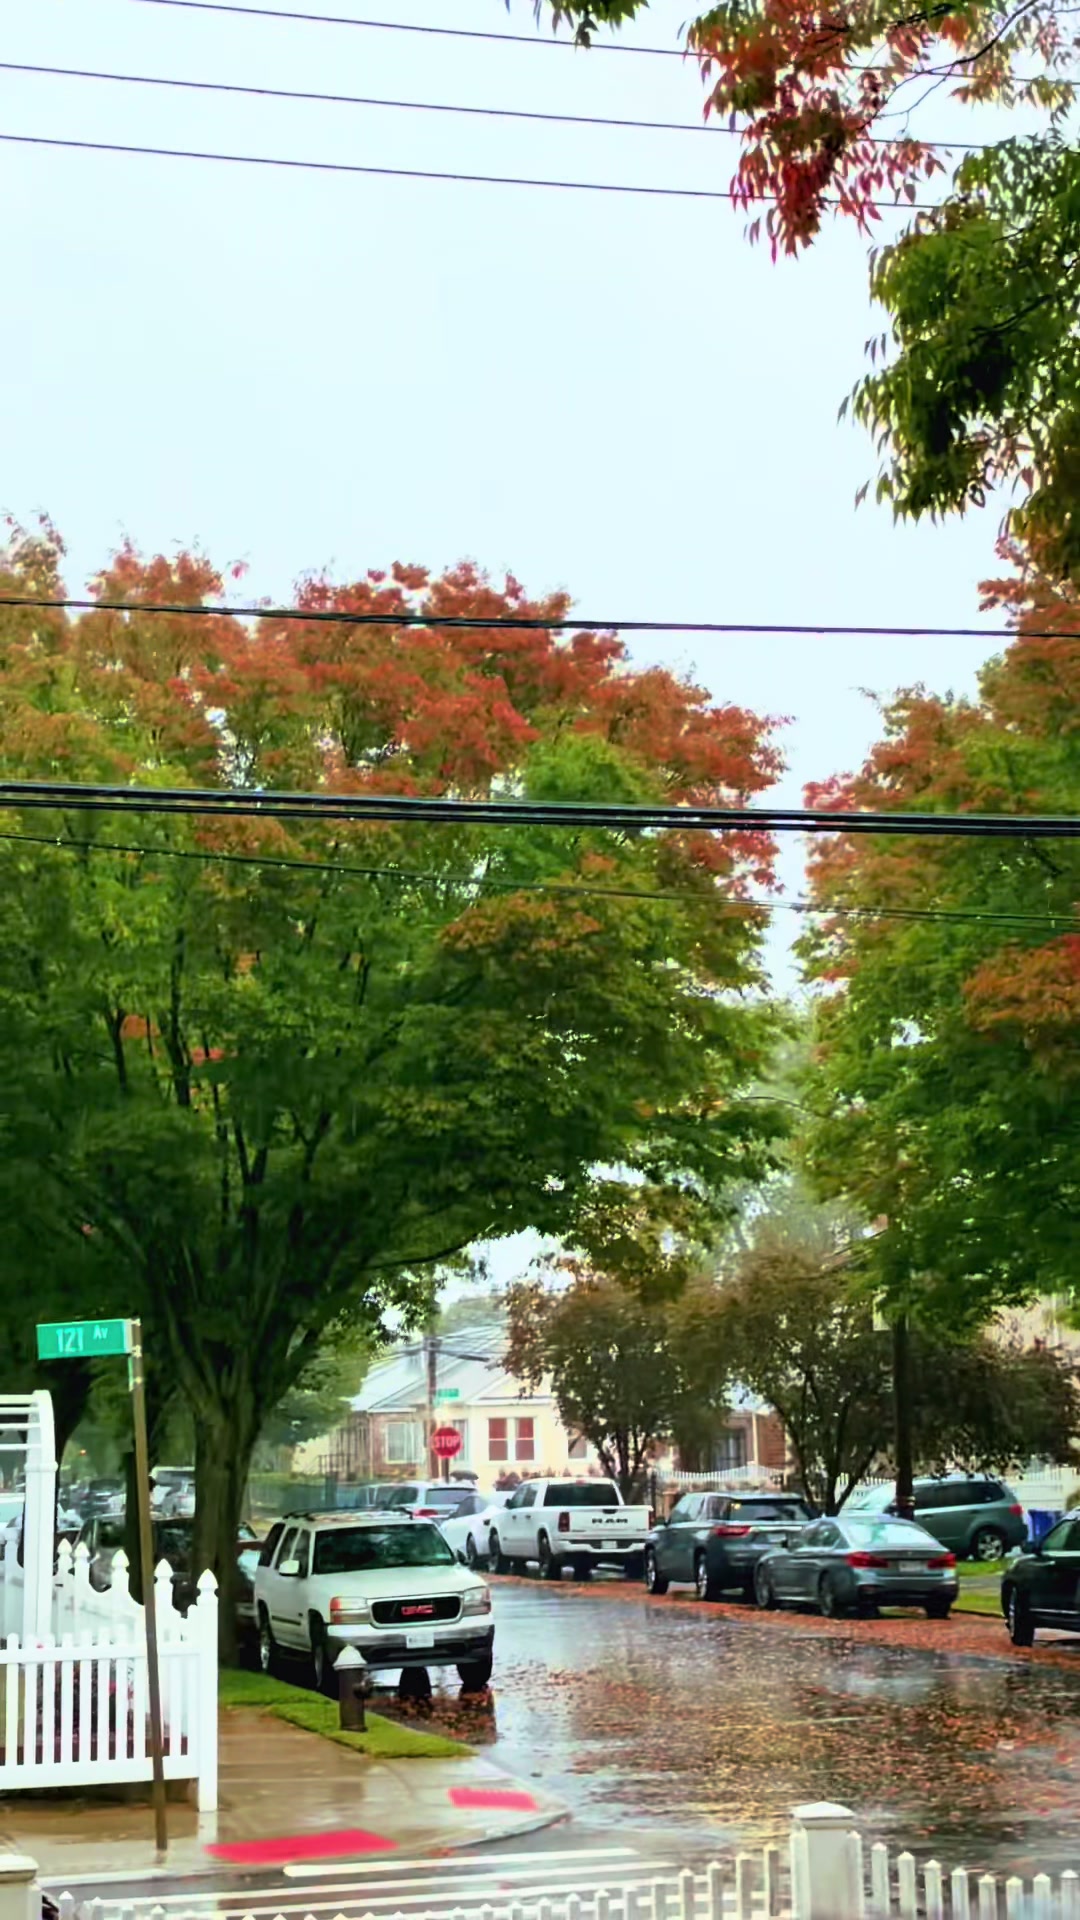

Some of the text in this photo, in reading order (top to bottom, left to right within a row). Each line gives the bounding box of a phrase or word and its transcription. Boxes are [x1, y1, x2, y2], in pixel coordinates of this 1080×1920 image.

[56, 1324, 108, 1352] 121 Av
[434, 1435, 461, 1448] STOP
